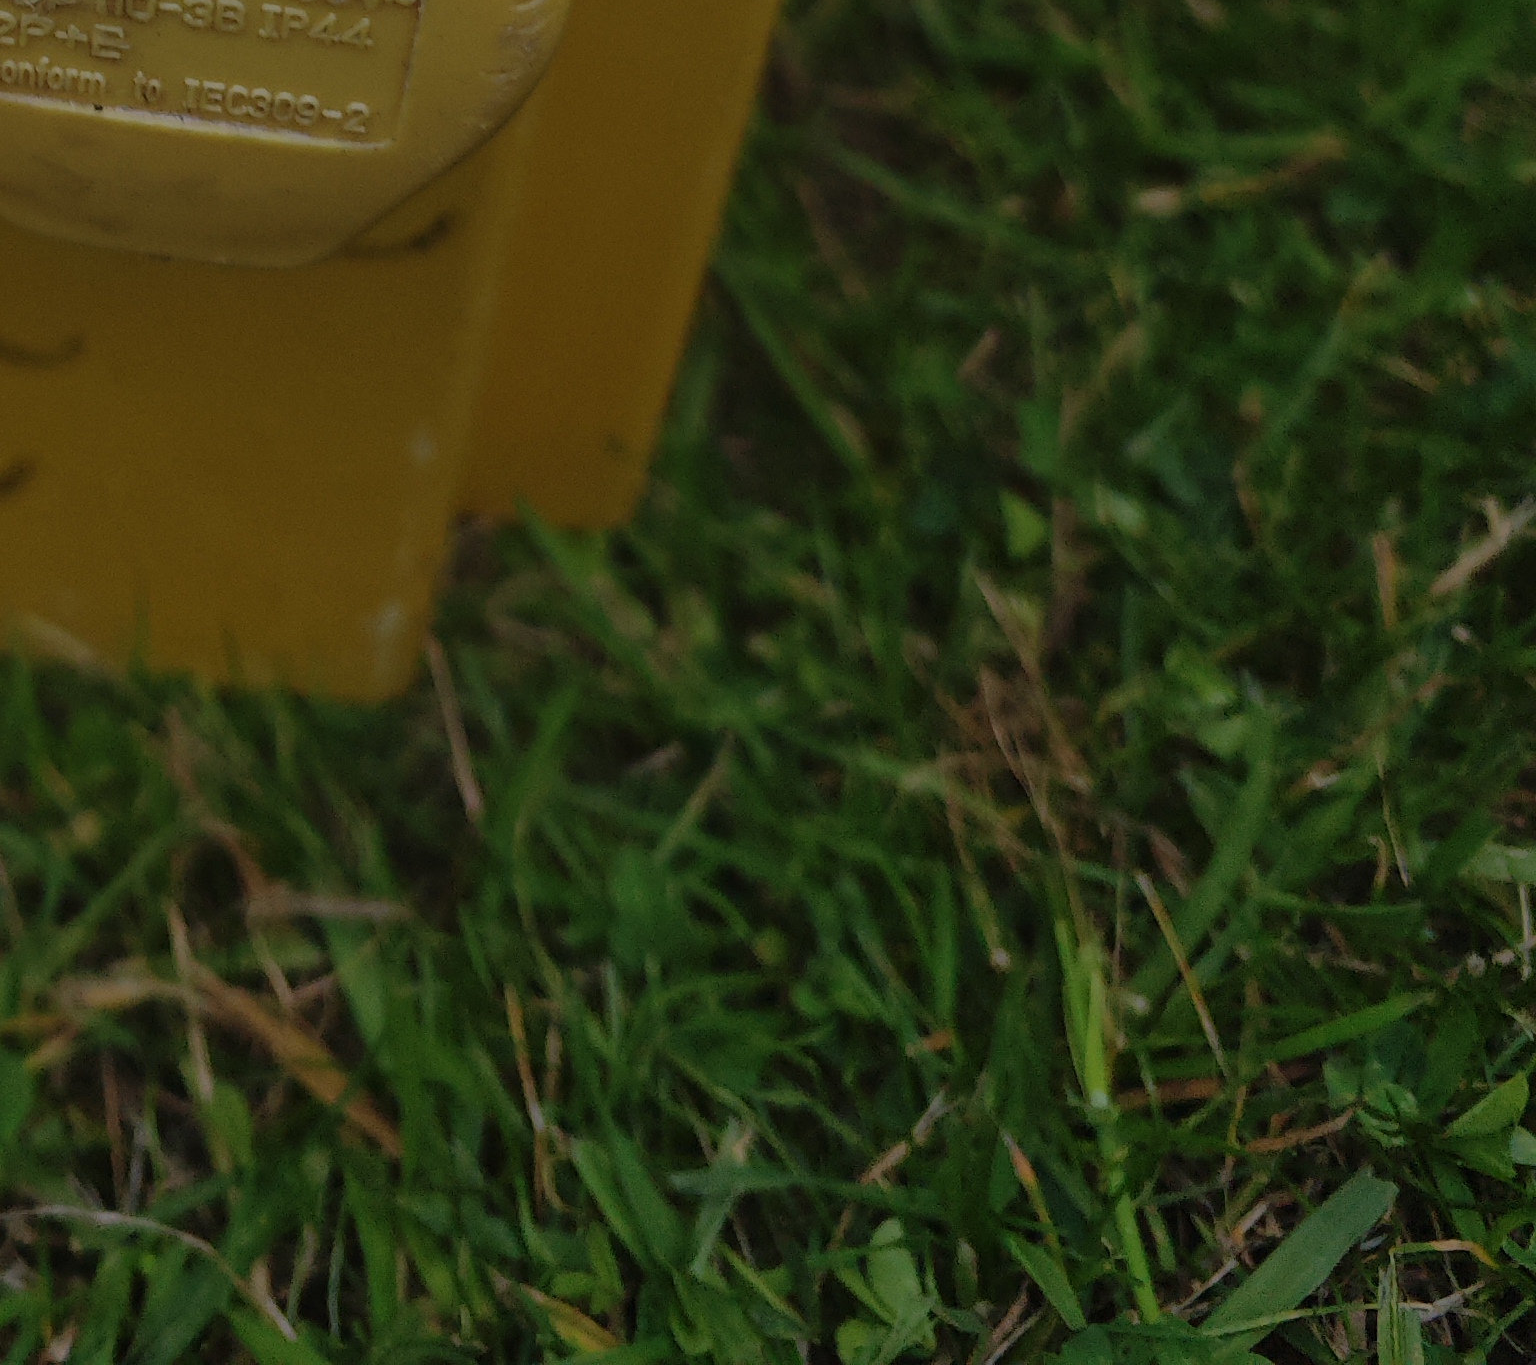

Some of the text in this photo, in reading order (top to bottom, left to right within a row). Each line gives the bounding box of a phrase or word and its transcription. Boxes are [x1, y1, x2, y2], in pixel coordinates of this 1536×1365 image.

[258, 2, 374, 48] IP44
[133, 70, 162, 104] to
[182, 76, 371, 135] IEC309-2
